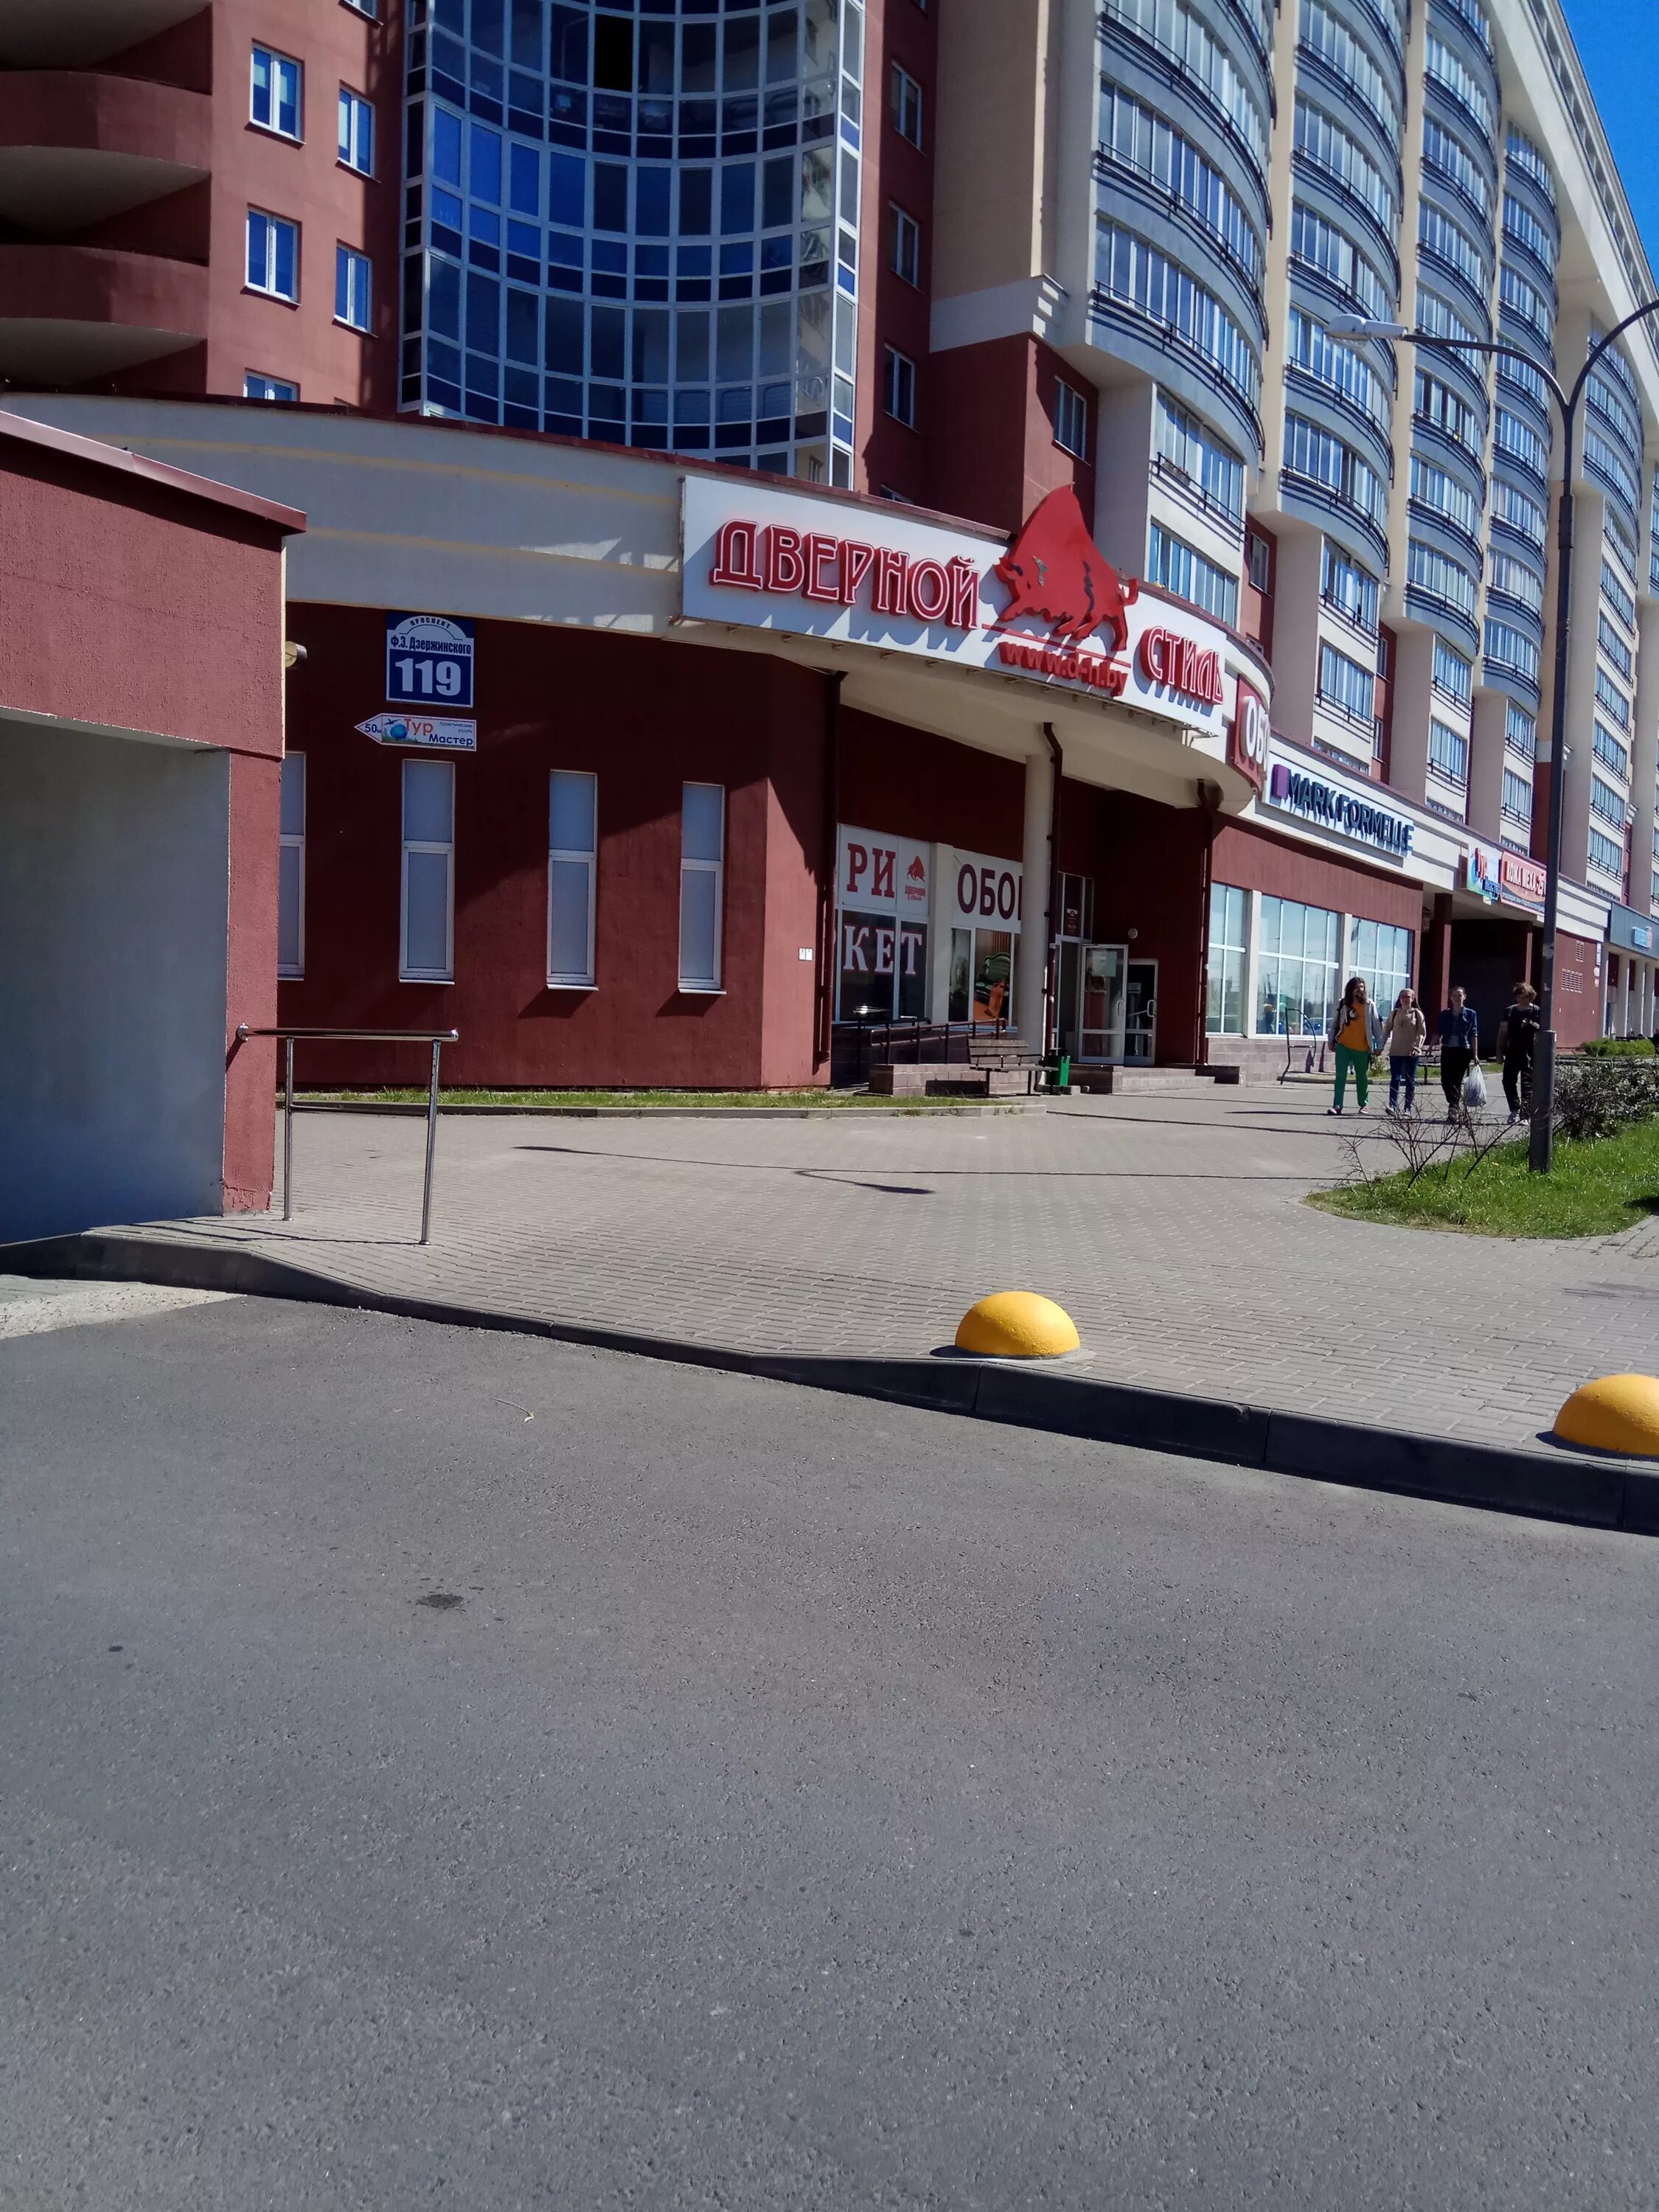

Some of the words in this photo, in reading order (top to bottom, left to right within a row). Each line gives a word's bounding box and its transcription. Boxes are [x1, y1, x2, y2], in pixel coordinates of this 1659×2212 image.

[710, 518, 981, 631] ДВЕРНОЙ
[409, 636, 471, 654] Дзержинского
[410, 617, 451, 629] ПРОСПЕКТ
[395, 658, 462, 696] 119
[998, 641, 1128, 698] www.d-h.by
[1140, 625, 1223, 704] СТИЛЬ
[404, 718, 434, 736] Тур
[429, 734, 473, 746] Мастер
[1288, 769, 1336, 819] MARK
[1337, 793, 1414, 851] FORMELLE
[846, 843, 896, 898] РИ
[958, 863, 1023, 920] ОБО
[843, 924, 922, 975] КЕТ
